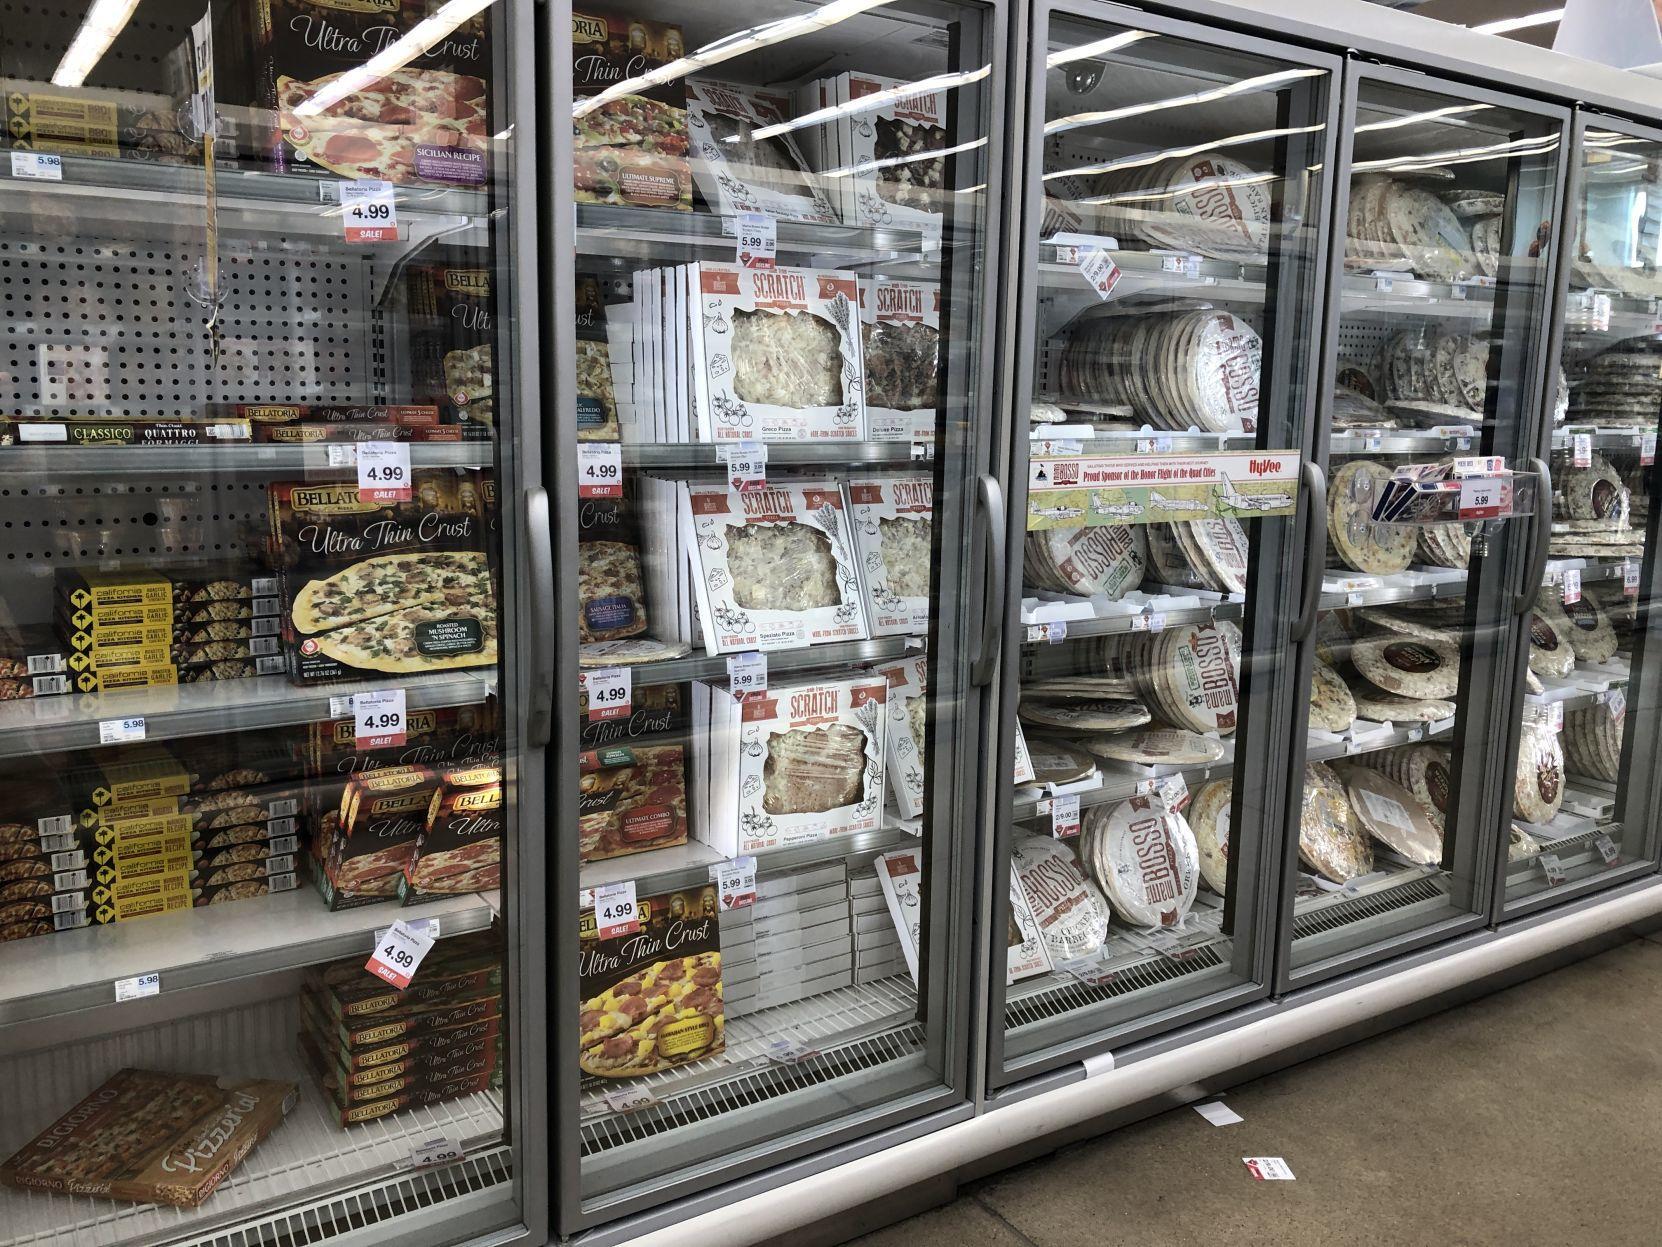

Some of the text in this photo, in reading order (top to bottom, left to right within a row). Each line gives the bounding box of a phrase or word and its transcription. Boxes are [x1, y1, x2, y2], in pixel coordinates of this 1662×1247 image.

[290, 15, 361, 52] Ultra
[575, 55, 622, 83] Thin
[37, 155, 60, 166] 5.98
[417, 148, 481, 162] SICILIAN RECIPE
[622, 173, 674, 185] ULTIMATE SUPREME
[353, 204, 389, 219] 4.99
[360, 230, 382, 239] SALE!
[742, 237, 761, 246] 5.99
[450, 273, 490, 287] BELLA
[753, 273, 805, 301] SCRATCH
[877, 288, 922, 313] SCRATCH
[247, 407, 388, 421] BELLATORIA Ultra Thin Crust
[74, 428, 131, 440] CLASSICO
[144, 428, 196, 439] QUATTRO
[275, 427, 413, 440] BELLATORIA Ultra Thin Crust
[367, 467, 404, 480] 4.99
[586, 465, 616, 478] 4.99
[732, 463, 750, 472] 5.99
[1060, 463, 1079, 480] BOSSO
[1084, 467, 1216, 482] Proud Sponsor of the Honor Flight of the Quad Cities
[1250, 460, 1280, 476] HyVee
[296, 489, 359, 506] BELLAT
[373, 490, 396, 498] SALE!
[1474, 496, 1488, 506] 5.99
[741, 491, 794, 515] SCRATCH
[580, 502, 619, 529] Crust
[298, 512, 472, 555] Ultra Thin Crust
[96, 588, 142, 596] california
[98, 609, 143, 618] california
[147, 612, 168, 620] GARLIC
[97, 630, 142, 638] california
[146, 632, 167, 640] GARLIC
[428, 626, 468, 635] MUSHROOM
[439, 632, 466, 640] SPINACH
[95, 650, 140, 660] california
[1196, 635, 1229, 692] BOSSO
[103, 670, 148, 680] california
[734, 675, 752, 684] 5.99
[596, 687, 626, 702] 4.99
[1204, 688, 1233, 710] mama
[601, 708, 620, 716] SALE!
[790, 692, 839, 719] SCRATCH
[123, 720, 144, 729] 5.98
[364, 714, 400, 728] 4.99
[583, 709, 673, 749] Thin Crust
[370, 736, 392, 746] SALE!
[452, 733, 499, 758] Crust
[372, 773, 422, 788] BELLATORIA
[626, 812, 670, 824] ULTIMATE COMBO
[784, 834, 806, 842] Pepperoni
[1129, 818, 1170, 884] BOSSO
[722, 878, 740, 890] 5.99
[1020, 854, 1081, 909] BOSSO
[604, 902, 632, 920] 4.99
[611, 924, 628, 934] SALE!
[580, 919, 711, 978] Ultra Thin Crust
[384, 945, 414, 968] 4.99
[378, 966, 398, 980] SALE!
[138, 975, 158, 986] 5.98
[351, 996, 396, 1012] BELLATORIA
[359, 1024, 404, 1041] BELLATORIA
[660, 1024, 698, 1039] HAWAIIAN STYLE
[361, 1046, 407, 1064] BELLATORIA
[357, 1066, 403, 1082] BELLATORIA
[357, 1082, 402, 1098] BELLATORIA
[37, 1088, 118, 1148] DIGIORNO
[350, 1102, 397, 1120] BELLATORIA
[422, 1152, 456, 1162] 4.99
[16, 1177, 63, 1190] DIGIORNO
[198, 1164, 230, 1199] DIGIORNO
